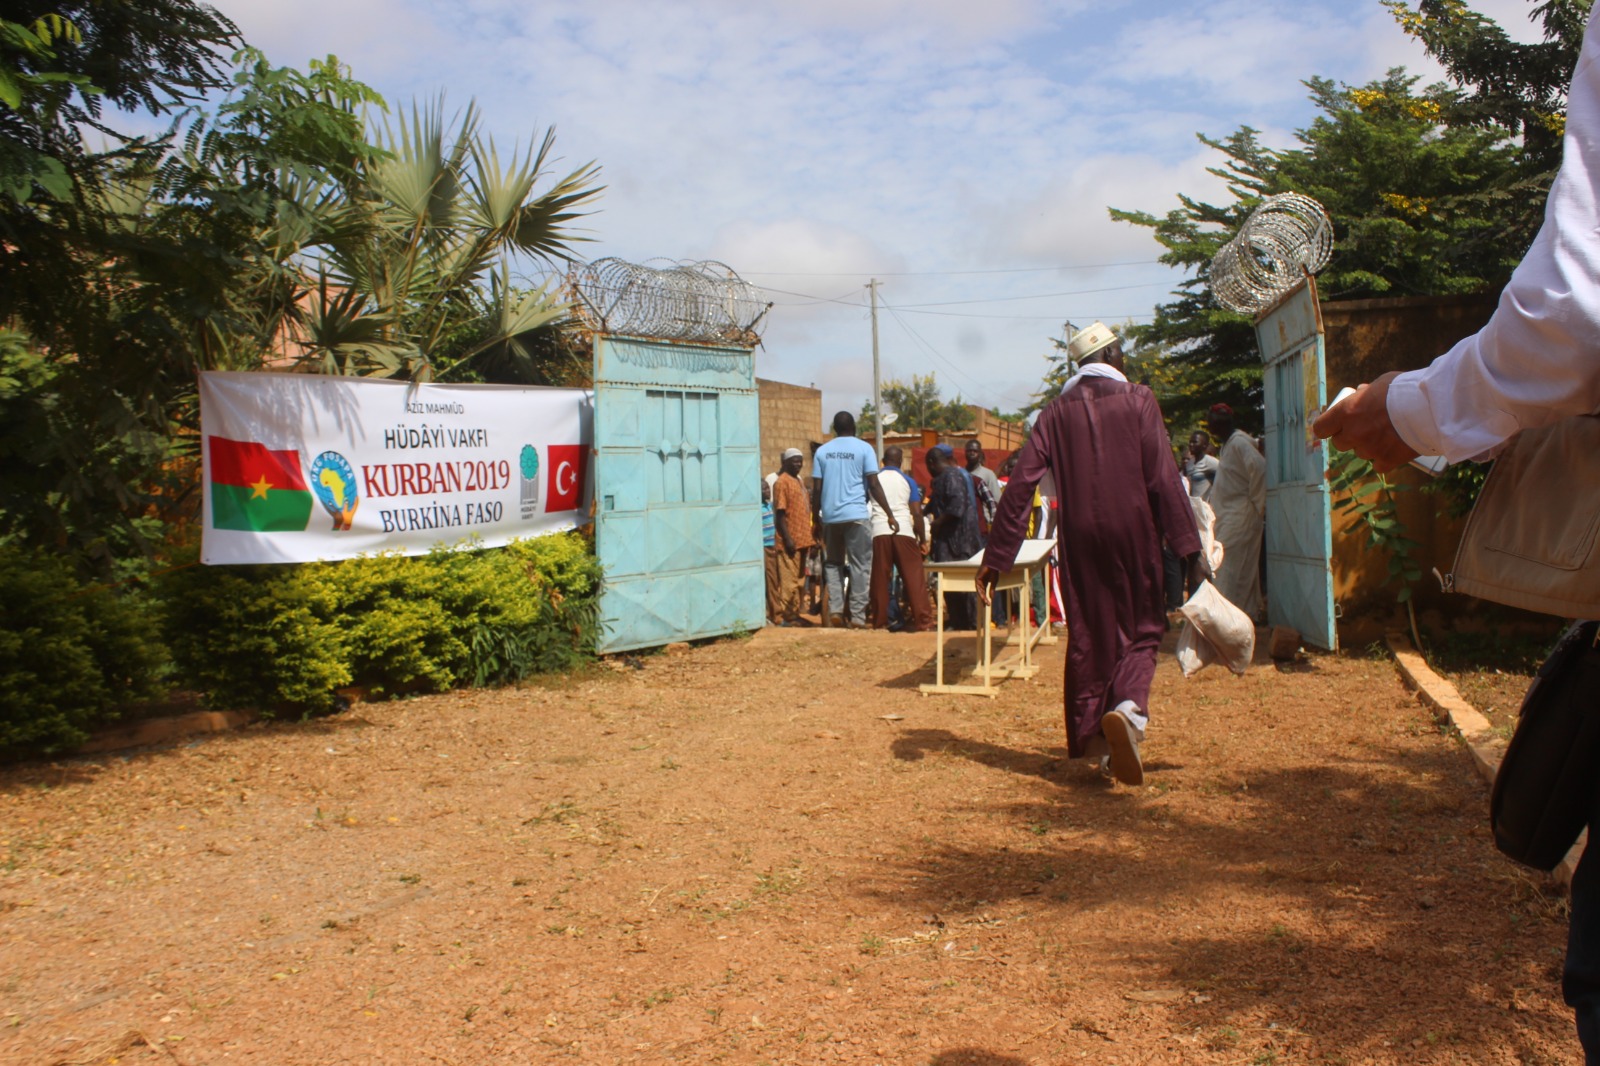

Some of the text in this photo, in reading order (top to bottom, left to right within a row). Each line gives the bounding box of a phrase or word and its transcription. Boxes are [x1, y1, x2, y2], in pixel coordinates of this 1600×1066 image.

[385, 424, 488, 449] HÜDÂYİ VAKFI
[361, 460, 511, 498] KURBAN 2019
[380, 501, 503, 533] BURKİNA FASO
